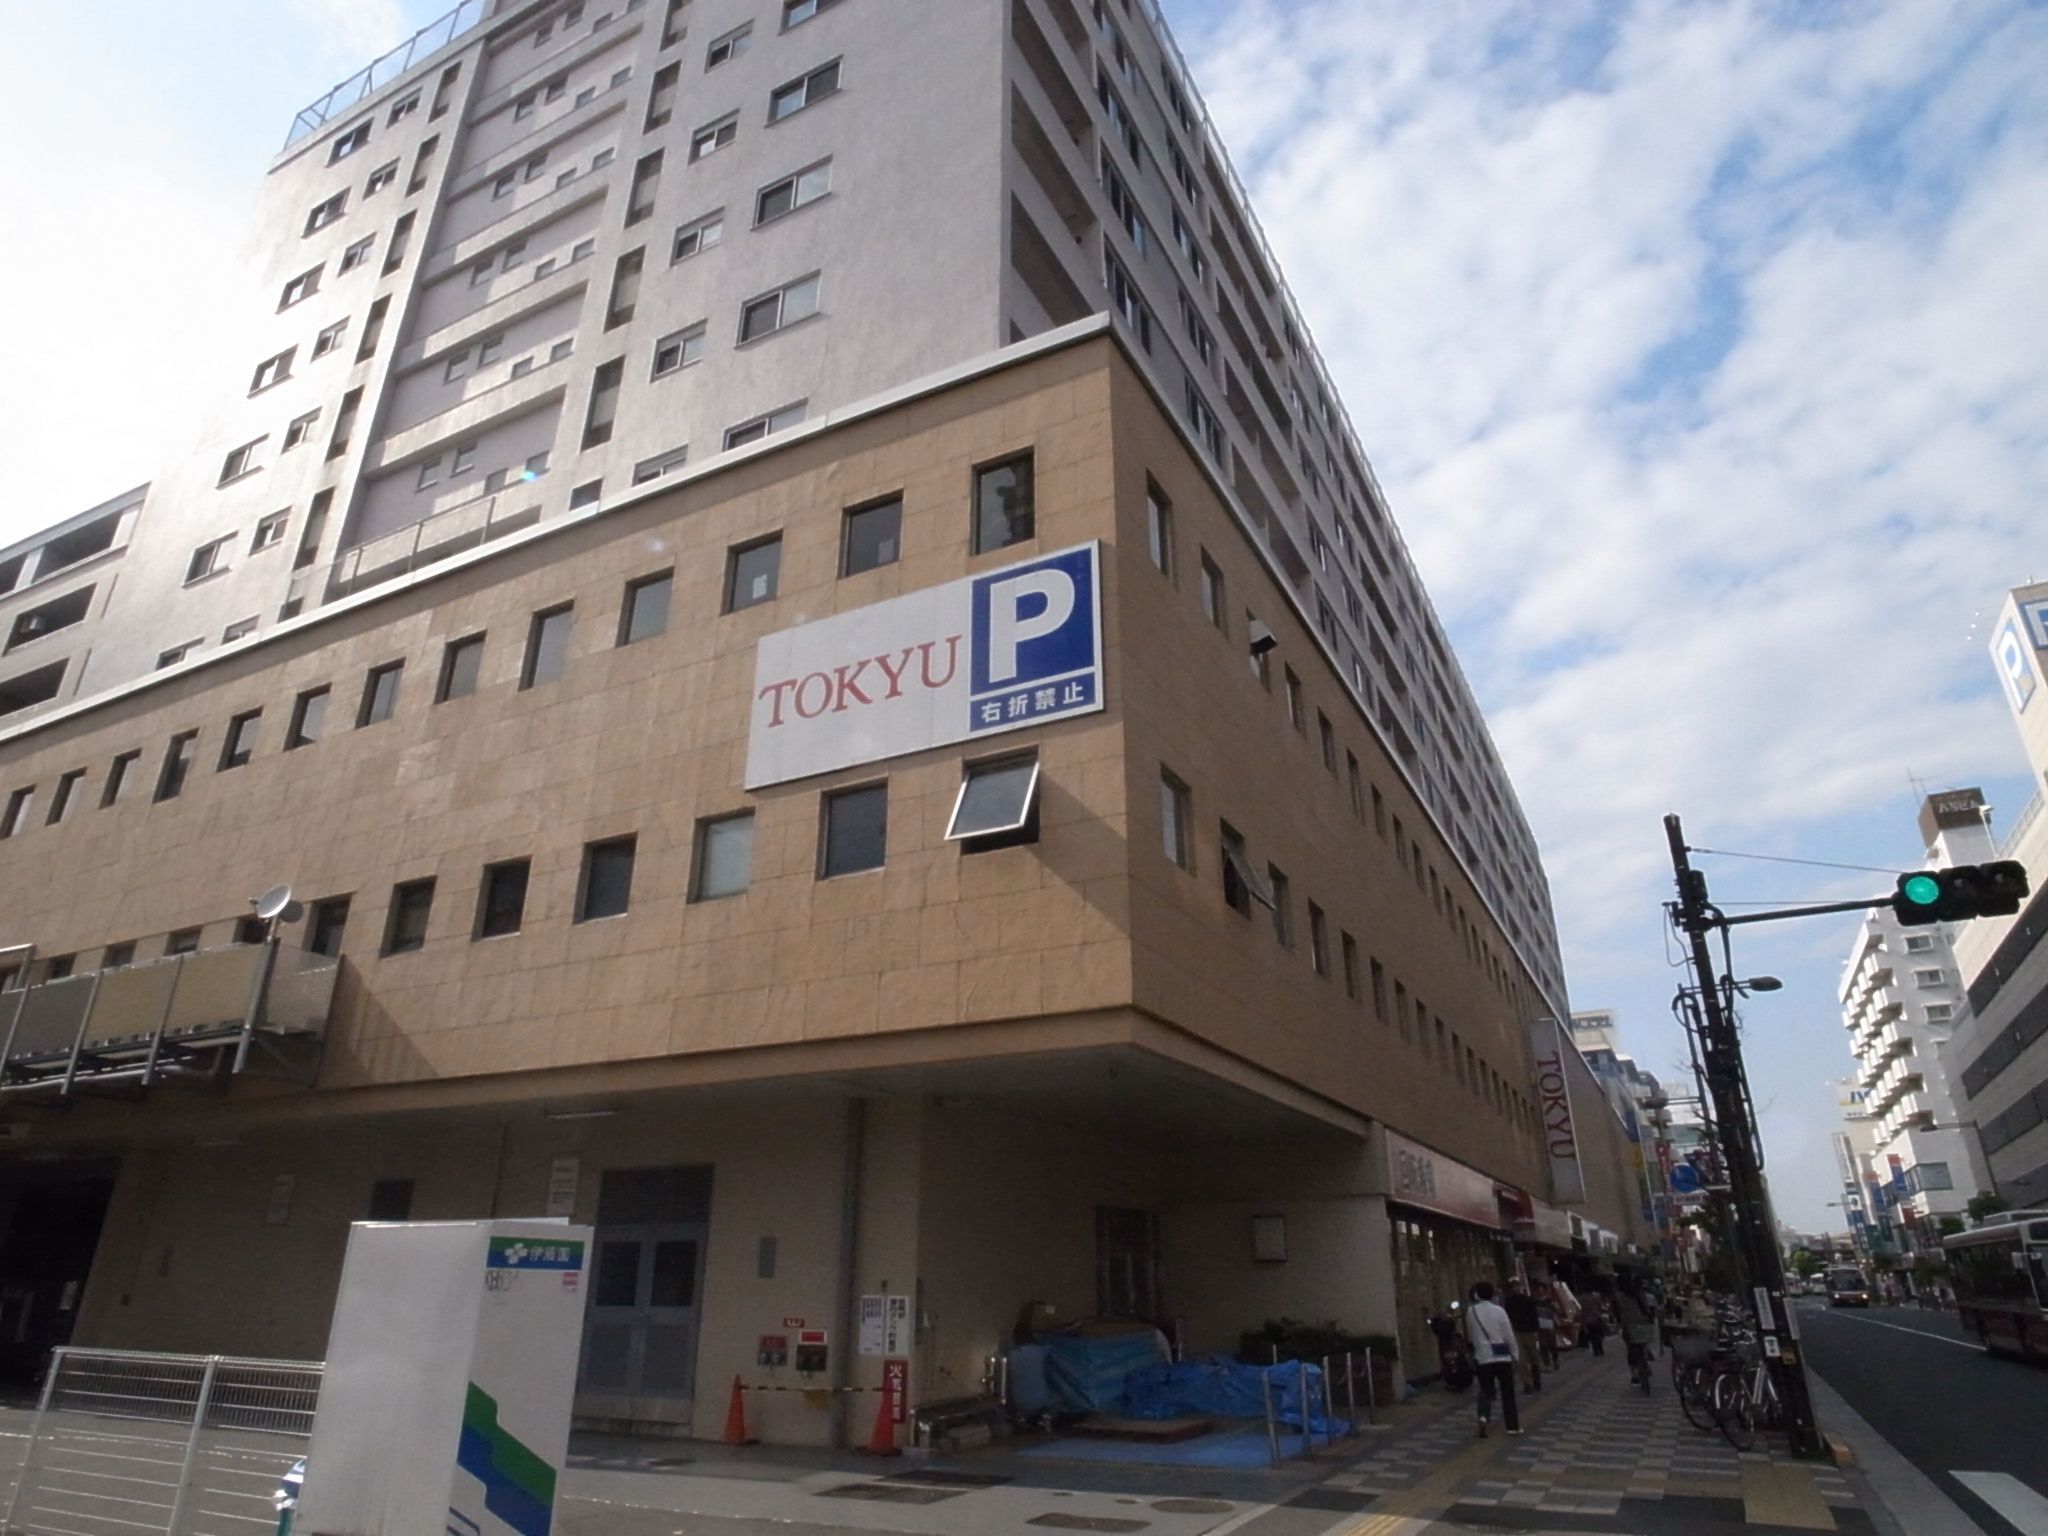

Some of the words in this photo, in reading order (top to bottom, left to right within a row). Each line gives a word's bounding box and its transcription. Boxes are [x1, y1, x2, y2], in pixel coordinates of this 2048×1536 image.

[988, 569, 1076, 684] P
[758, 634, 963, 728] TOKYU
[981, 681, 1085, 724] 右折禁止
[1537, 1050, 1577, 1159] TOKYU
